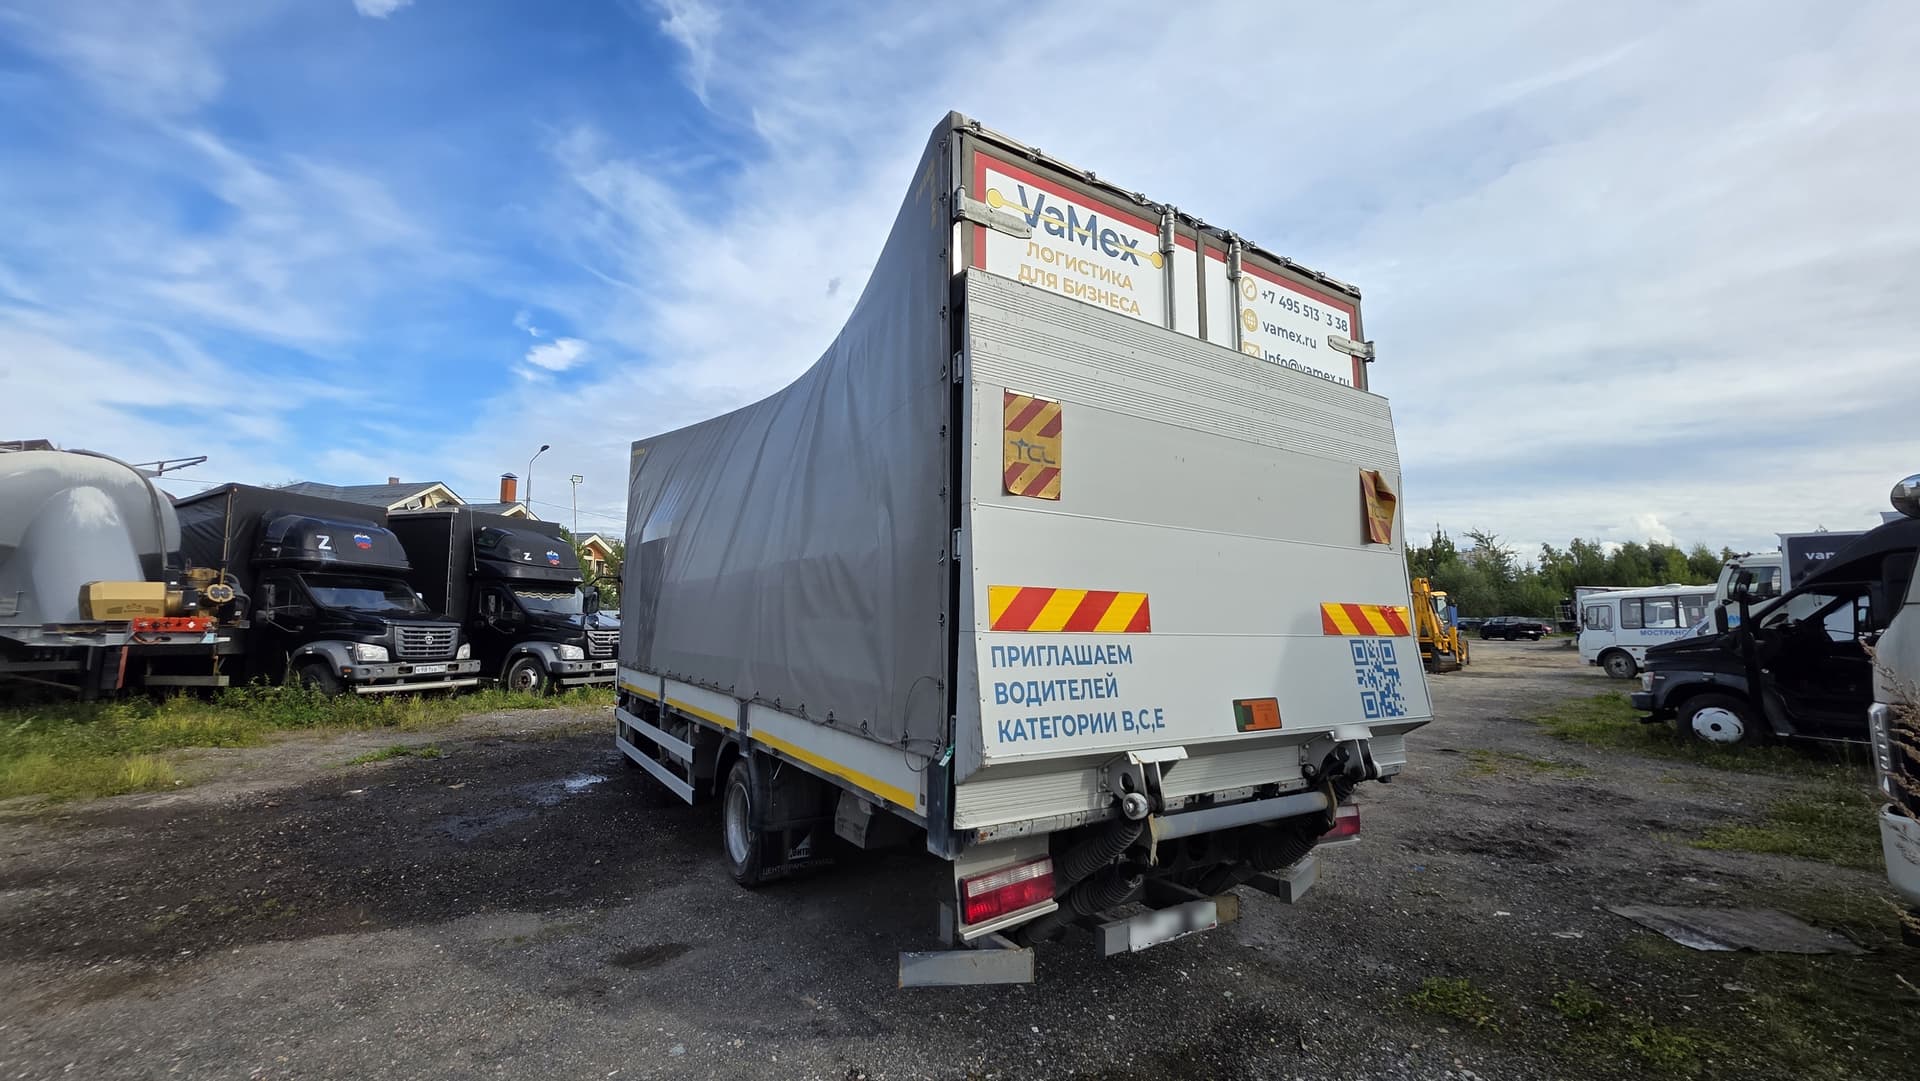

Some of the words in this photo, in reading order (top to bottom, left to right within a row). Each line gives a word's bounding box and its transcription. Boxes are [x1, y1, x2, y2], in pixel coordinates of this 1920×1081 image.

[1017, 184, 1140, 267] VaMex
[1027, 241, 1133, 291] ЛОГИСТИКА
[1018, 263, 1058, 290] ДЛЯ
[1063, 277, 1142, 316] БИЗНЕСА
[1261, 289, 1275, 304] +7
[1279, 295, 1300, 314] 495
[1303, 304, 1320, 322] 513
[1335, 316, 1349, 332] 38
[1262, 321, 1317, 349] vamex.ru
[1009, 438, 1056, 465] TCL
[991, 644, 1133, 668] ПРИГЛАШАЕМ
[994, 672, 1119, 707] ВОДИТЕЛЕЙ
[998, 711, 1118, 743] КАТЕГОРИИ
